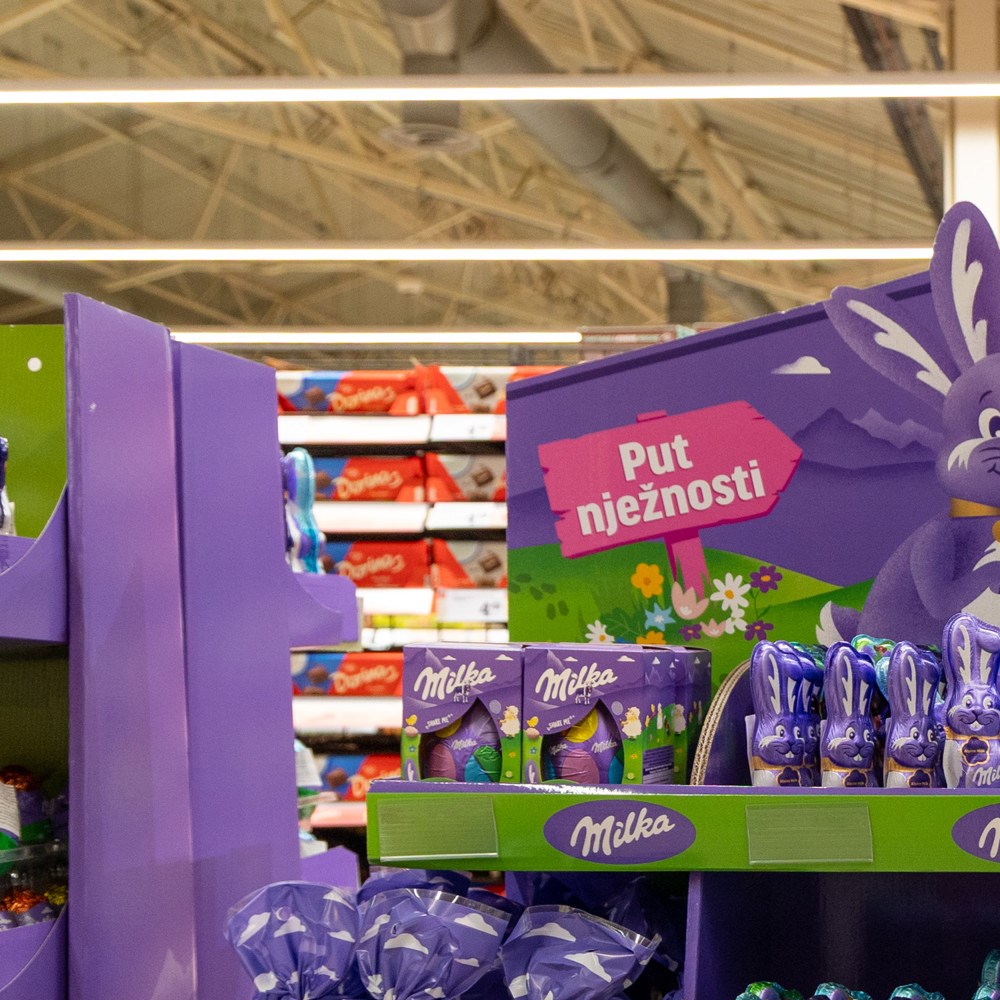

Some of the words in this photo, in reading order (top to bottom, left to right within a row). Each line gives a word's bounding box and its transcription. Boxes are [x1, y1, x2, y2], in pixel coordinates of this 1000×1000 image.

[618, 434, 693, 481] Put
[577, 461, 766, 537] nježnosti
[414, 662, 496, 700] Milka
[535, 662, 618, 701] Milka
[571, 808, 675, 856] Milka
